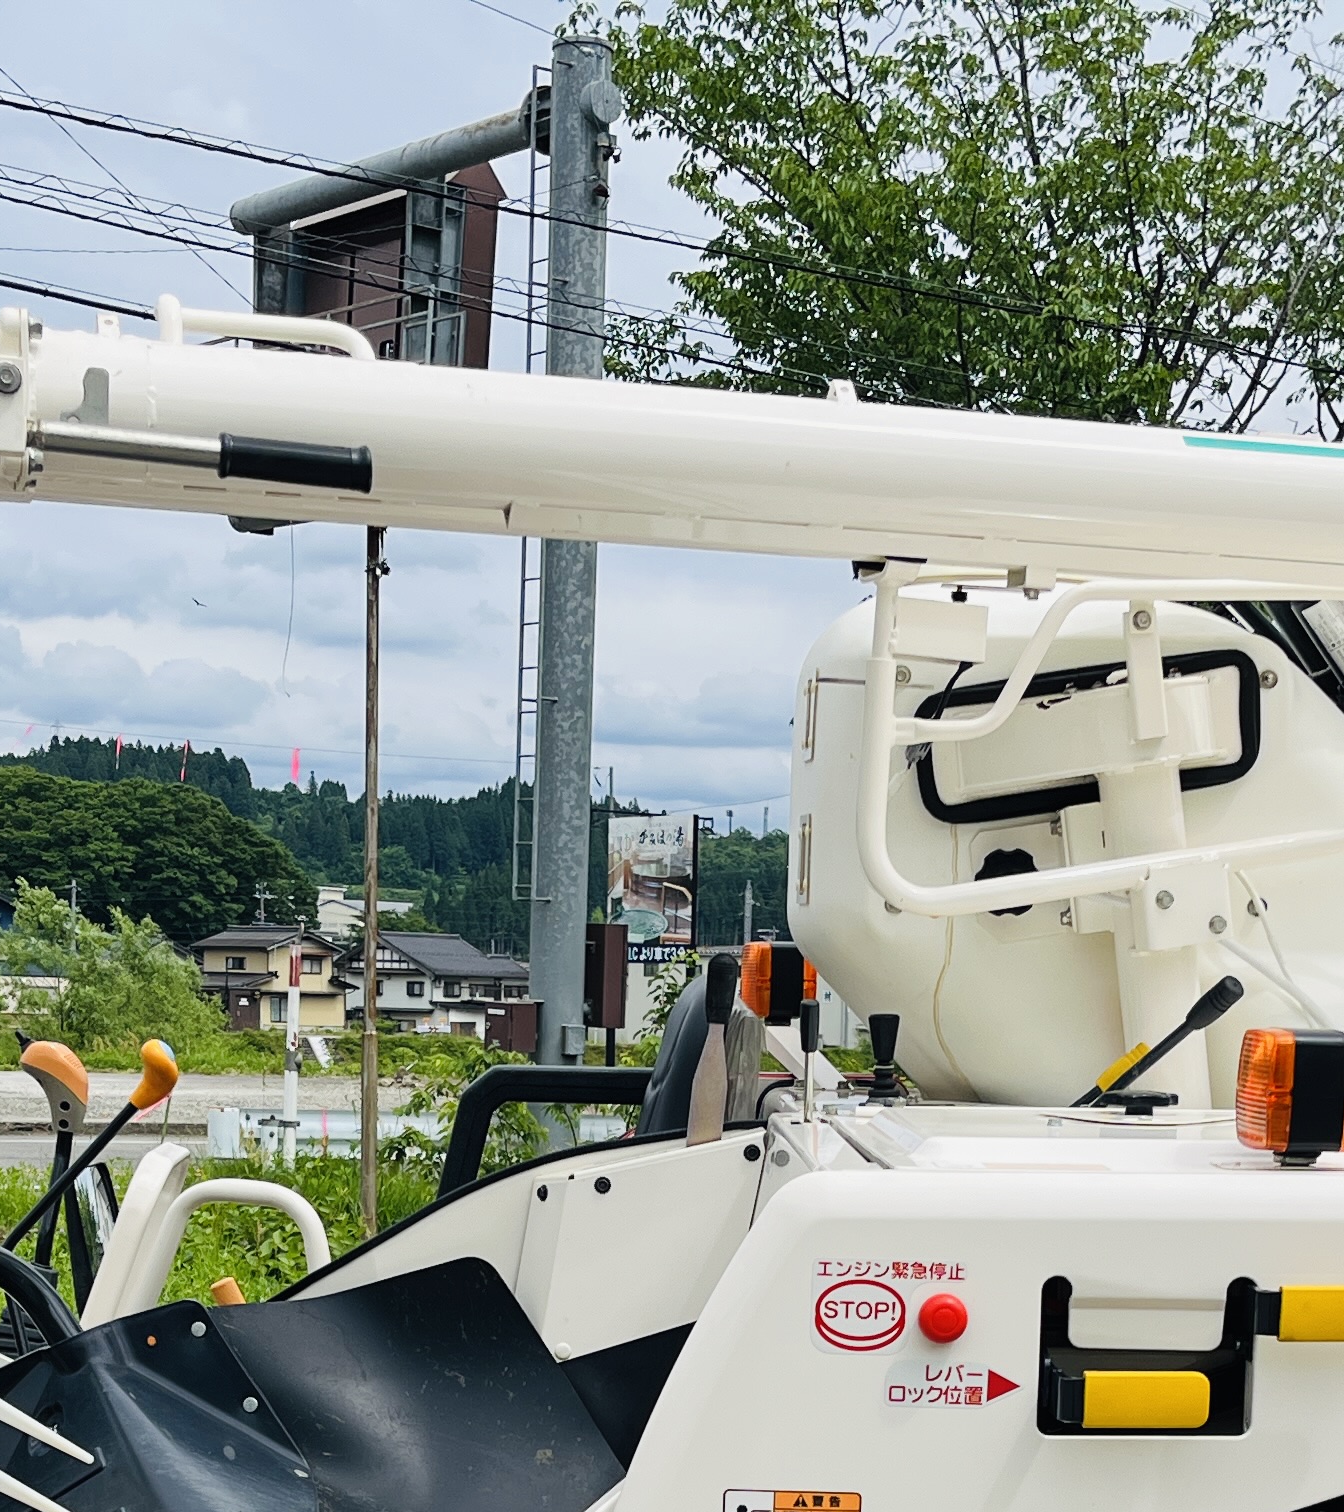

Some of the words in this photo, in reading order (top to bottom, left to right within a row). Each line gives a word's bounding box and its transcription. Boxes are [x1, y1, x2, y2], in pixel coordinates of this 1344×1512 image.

[817, 1261, 966, 1281] エンジン緊急停止
[823, 1301, 896, 1321] STOP!
[925, 1364, 983, 1383] レバー
[888, 1385, 983, 1406] ロック位置
[812, 1495, 841, 1508] 警告
